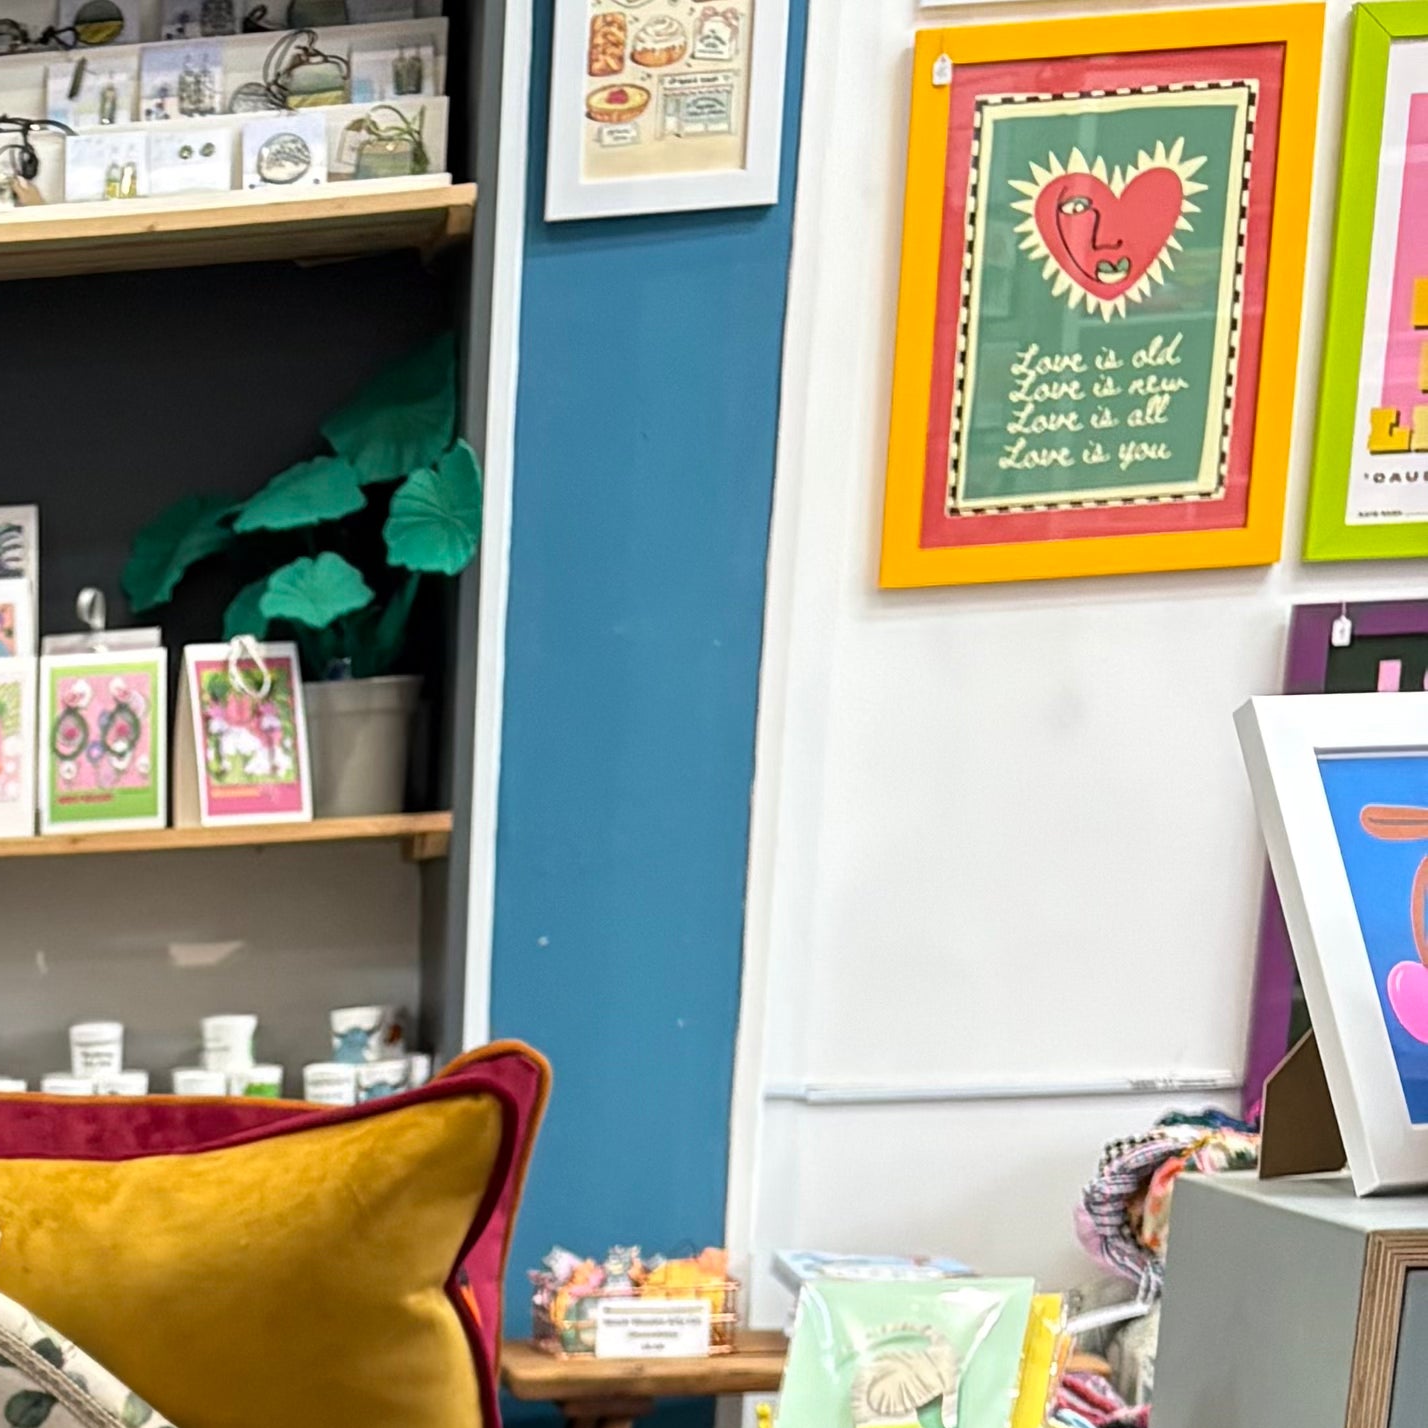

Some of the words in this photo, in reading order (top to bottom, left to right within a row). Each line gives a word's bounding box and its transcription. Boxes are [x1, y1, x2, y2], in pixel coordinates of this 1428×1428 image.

[1011, 343, 1088, 375] Love
[1095, 347, 1124, 370] is
[1131, 331, 1184, 368] old
[1008, 370, 1086, 402] Love
[1092, 374, 1122, 398] is
[1128, 375, 1189, 396] new
[1007, 402, 1084, 434] Love
[1090, 405, 1120, 429] is
[1127, 393, 1171, 427] all
[999, 437, 1075, 469] Love
[1082, 440, 1111, 465] is
[1118, 441, 1173, 471] you
